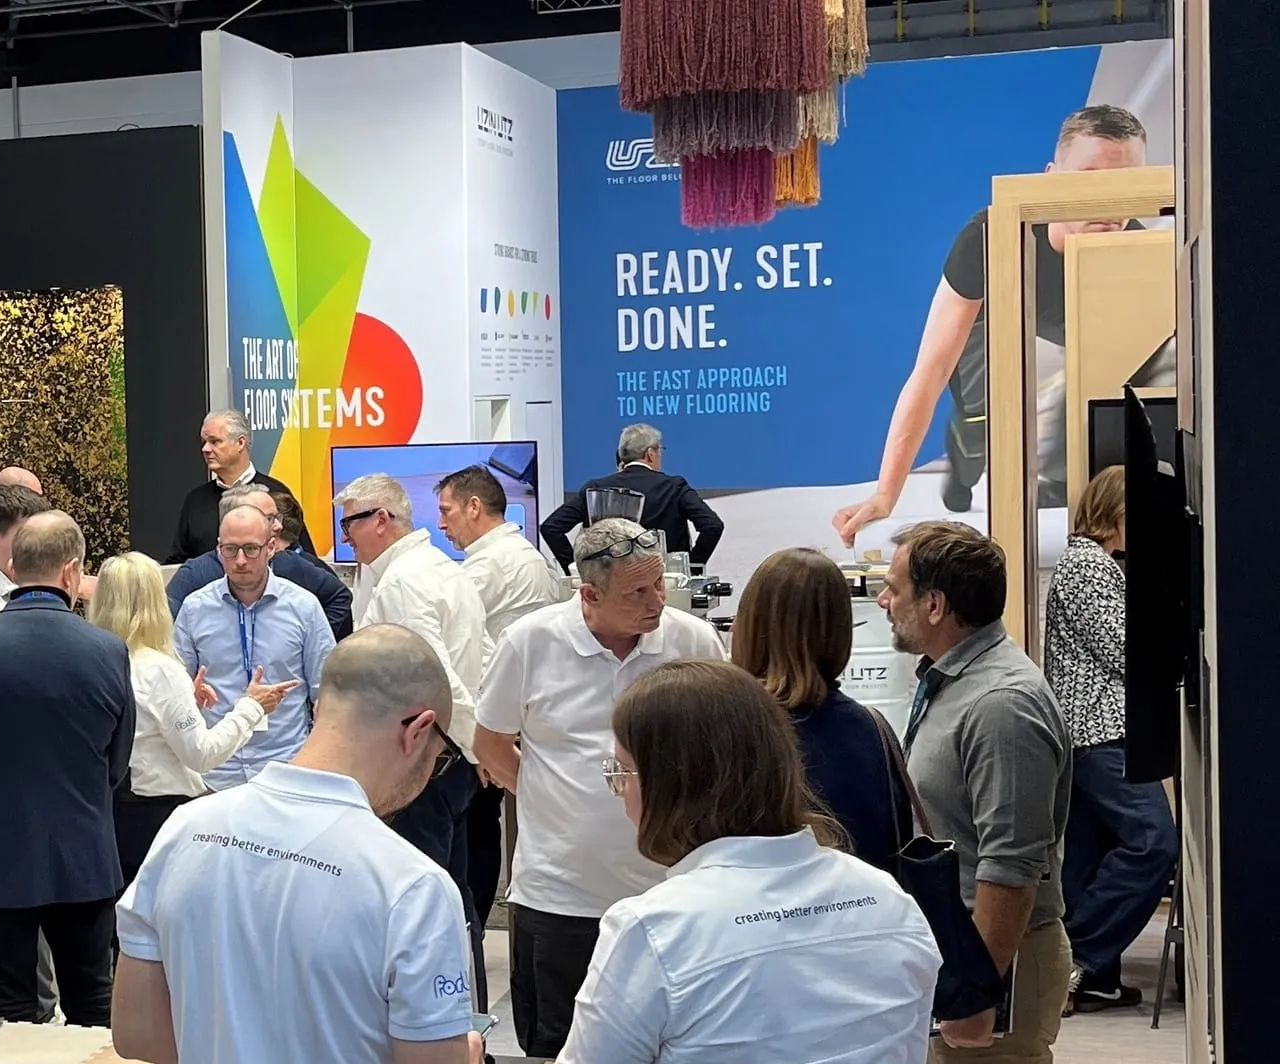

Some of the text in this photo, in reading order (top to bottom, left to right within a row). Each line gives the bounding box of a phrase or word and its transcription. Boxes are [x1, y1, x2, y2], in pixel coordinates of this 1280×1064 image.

[607, 177, 625, 185] THE
[628, 174, 658, 184] FLOOR
[616, 242, 833, 297] READY. SET.
[617, 304, 727, 352] DONE.
[242, 337, 263, 380] THE
[266, 338, 284, 380] ART
[617, 365, 787, 392] THE FAST APPROACH
[244, 388, 277, 431] FLOOR
[617, 391, 770, 417] TO NEW FLOORING
[192, 832, 343, 877] creating better environments
[734, 895, 878, 926] creating better environments
